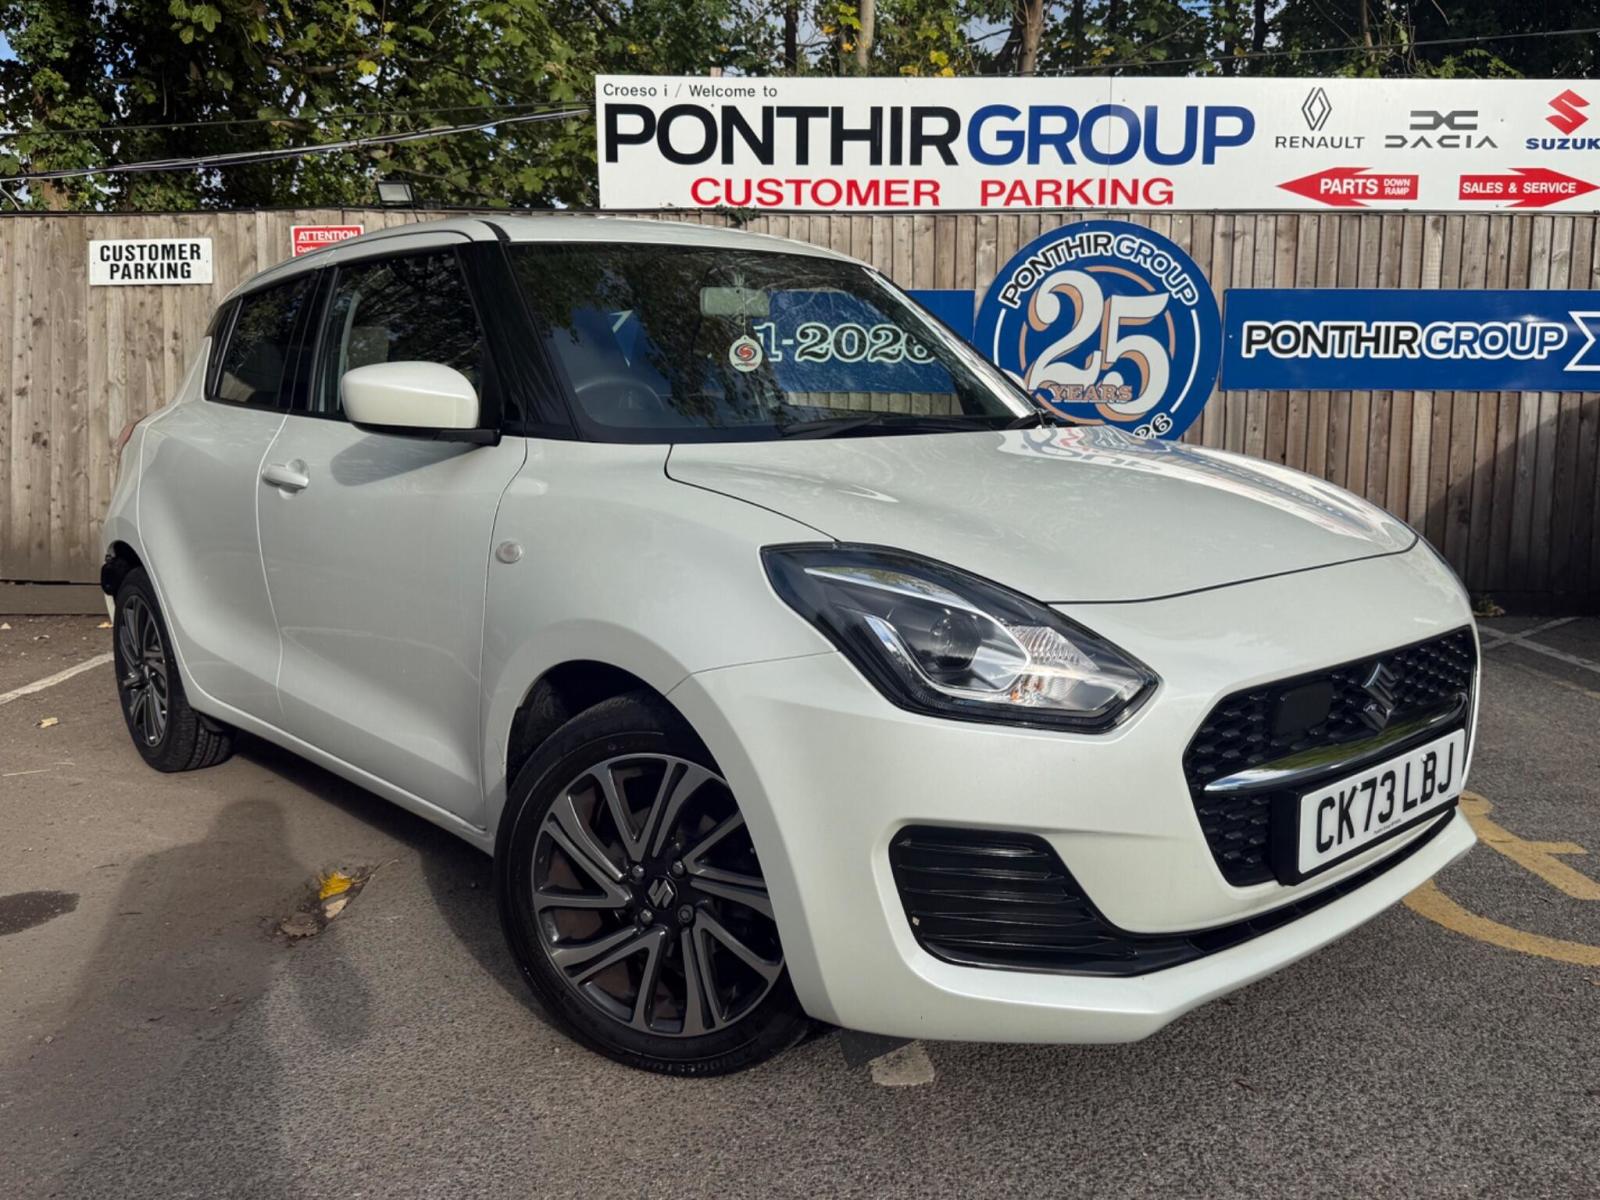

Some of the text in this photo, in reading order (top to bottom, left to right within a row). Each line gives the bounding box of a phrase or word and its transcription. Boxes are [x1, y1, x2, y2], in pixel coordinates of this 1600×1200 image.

[603, 83, 657, 97] Croeso
[663, 84, 668, 97] i
[689, 84, 756, 98] Welcome
[763, 85, 778, 97] to
[1275, 135, 1365, 149] RENAULT
[1385, 135, 1498, 149] DACIA
[1320, 178, 1379, 195] PARTS
[1383, 178, 1411, 187] DOWN
[1462, 181, 1577, 194] SALES & SERVICE
[690, 177, 1174, 207] CUSTOMER PARKING
[1384, 187, 1410, 196] RAMP
[298, 230, 358, 241] ATTENTION
[100, 243, 201, 262] CUSTOMER
[110, 262, 192, 280] PARKING
[1028, 270, 1170, 418] 25
[1048, 384, 1133, 404] YEARS
[1316, 742, 1454, 853] CK73 LBJ
